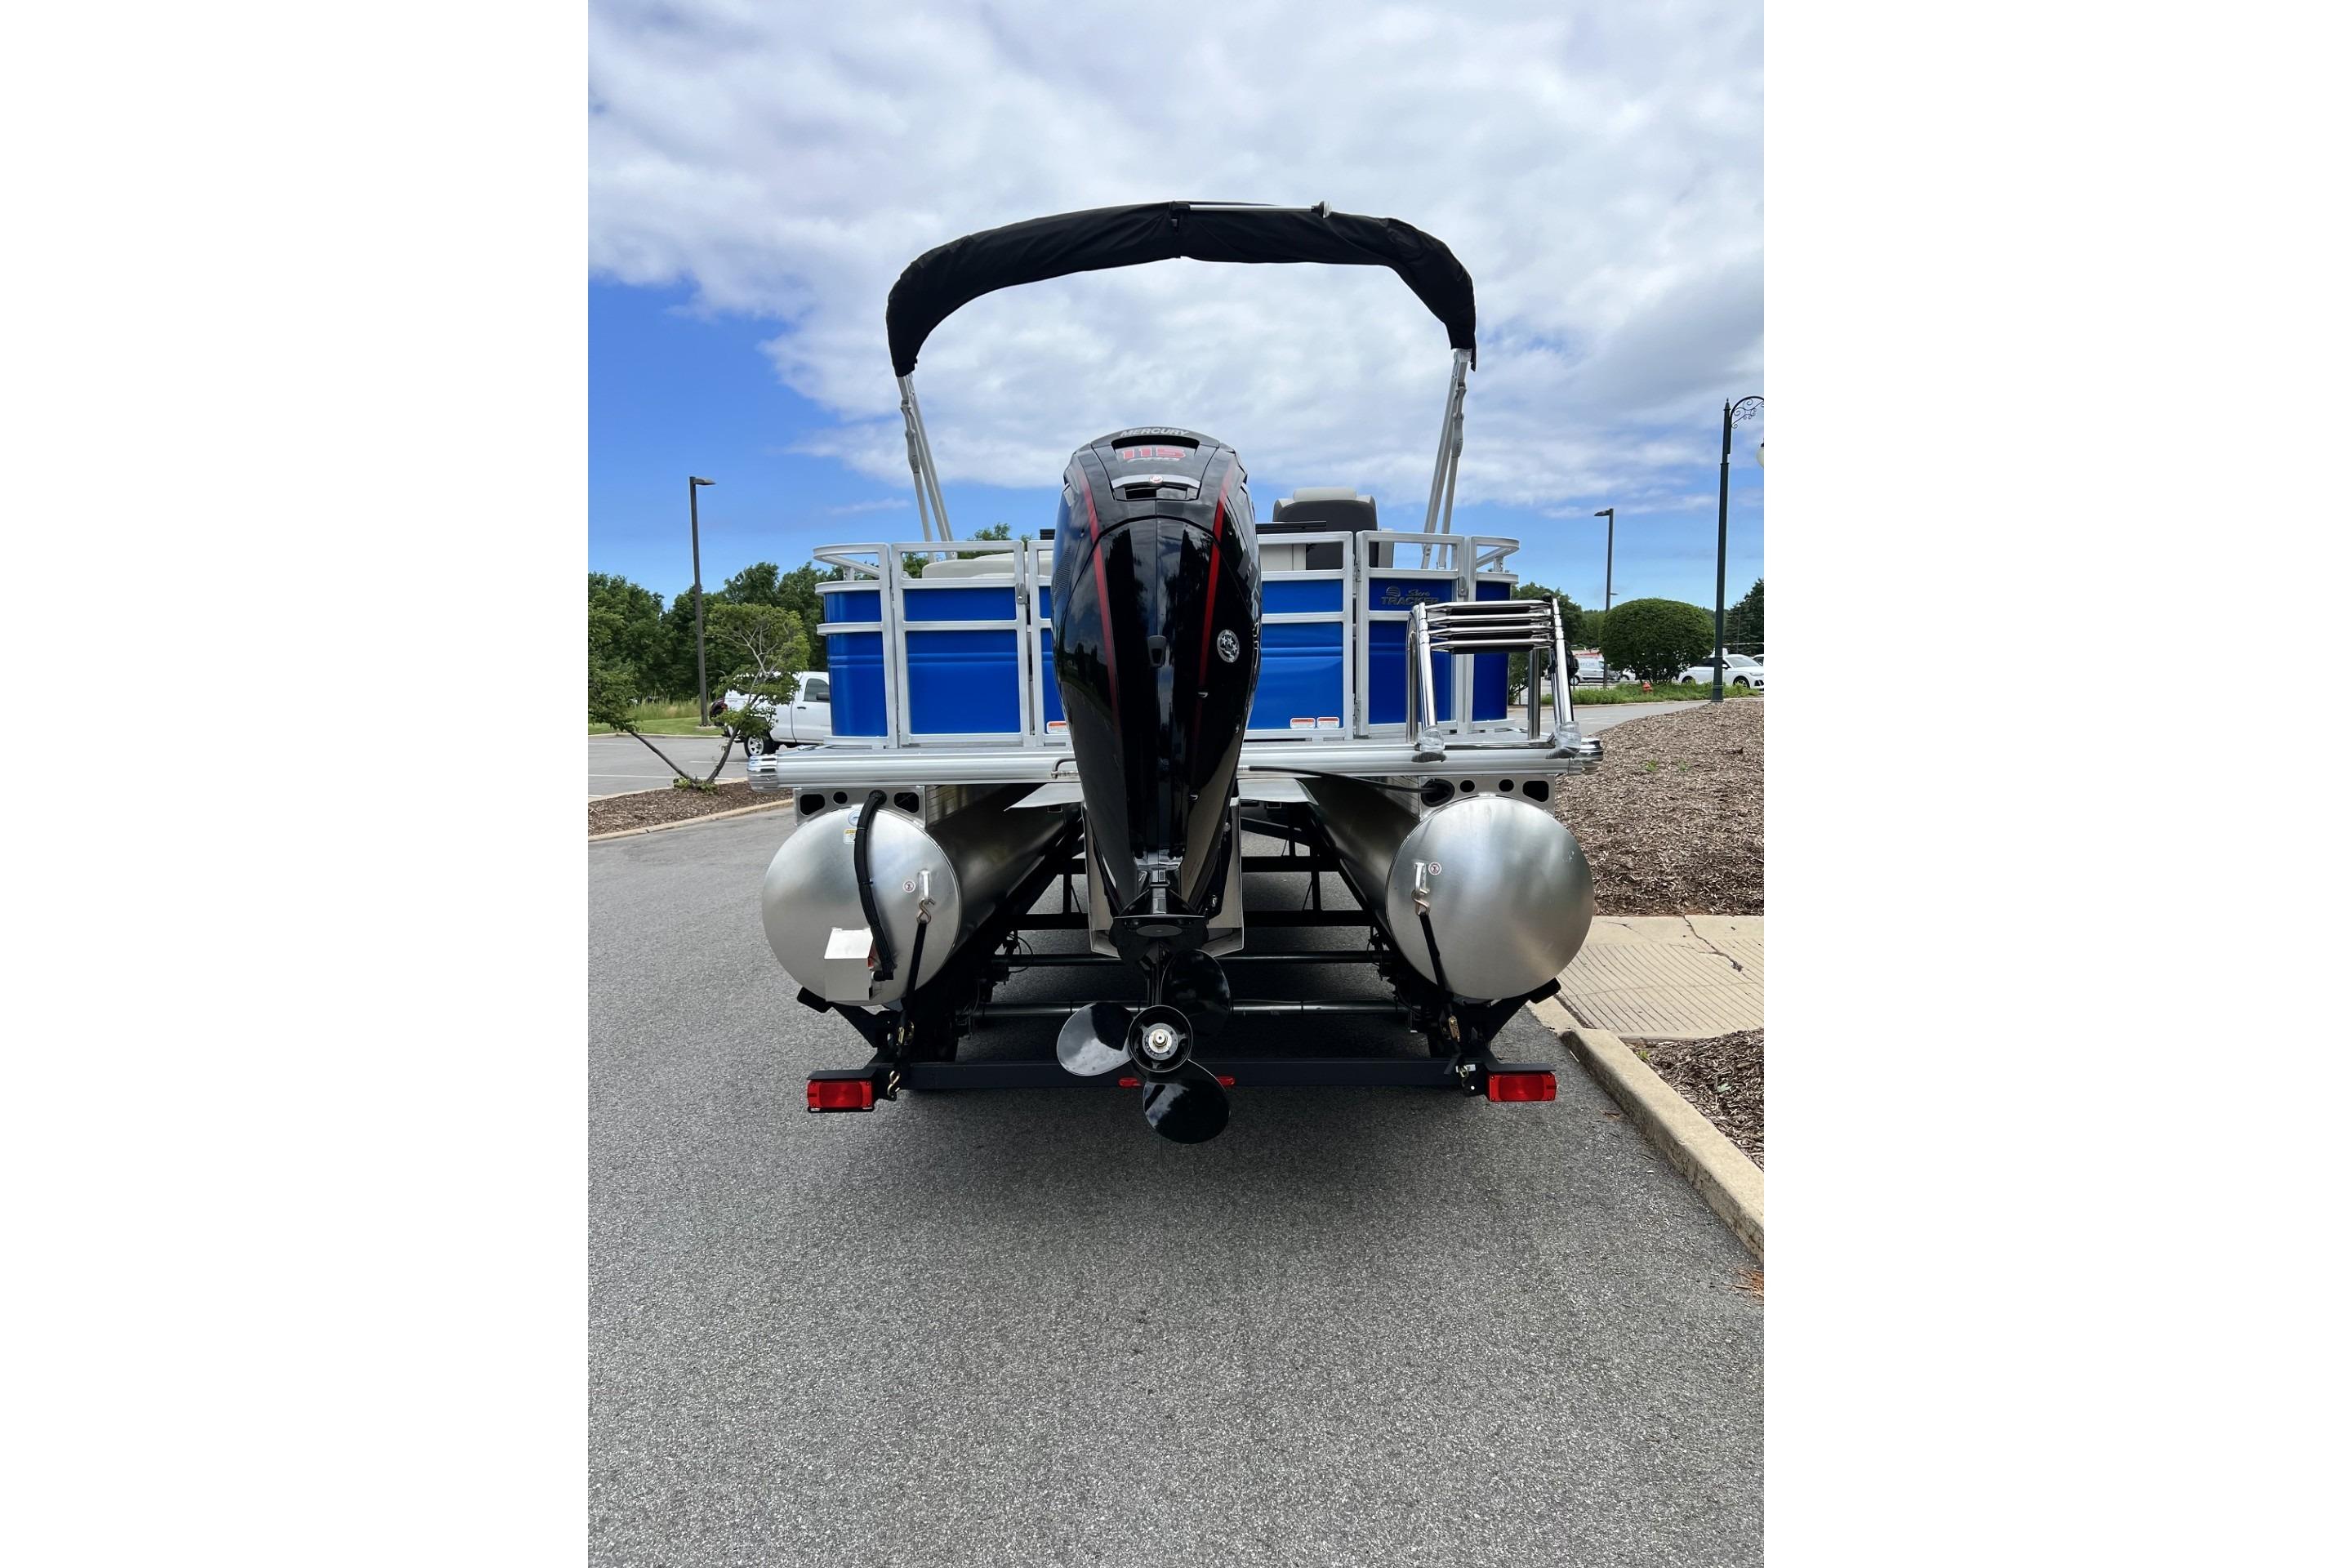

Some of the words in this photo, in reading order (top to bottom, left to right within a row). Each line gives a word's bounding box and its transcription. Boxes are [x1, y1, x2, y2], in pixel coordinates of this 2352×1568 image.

[1120, 428, 1190, 438] MERCURY
[1122, 447, 1187, 460] 115
[1381, 596, 1440, 605] TRACKER
